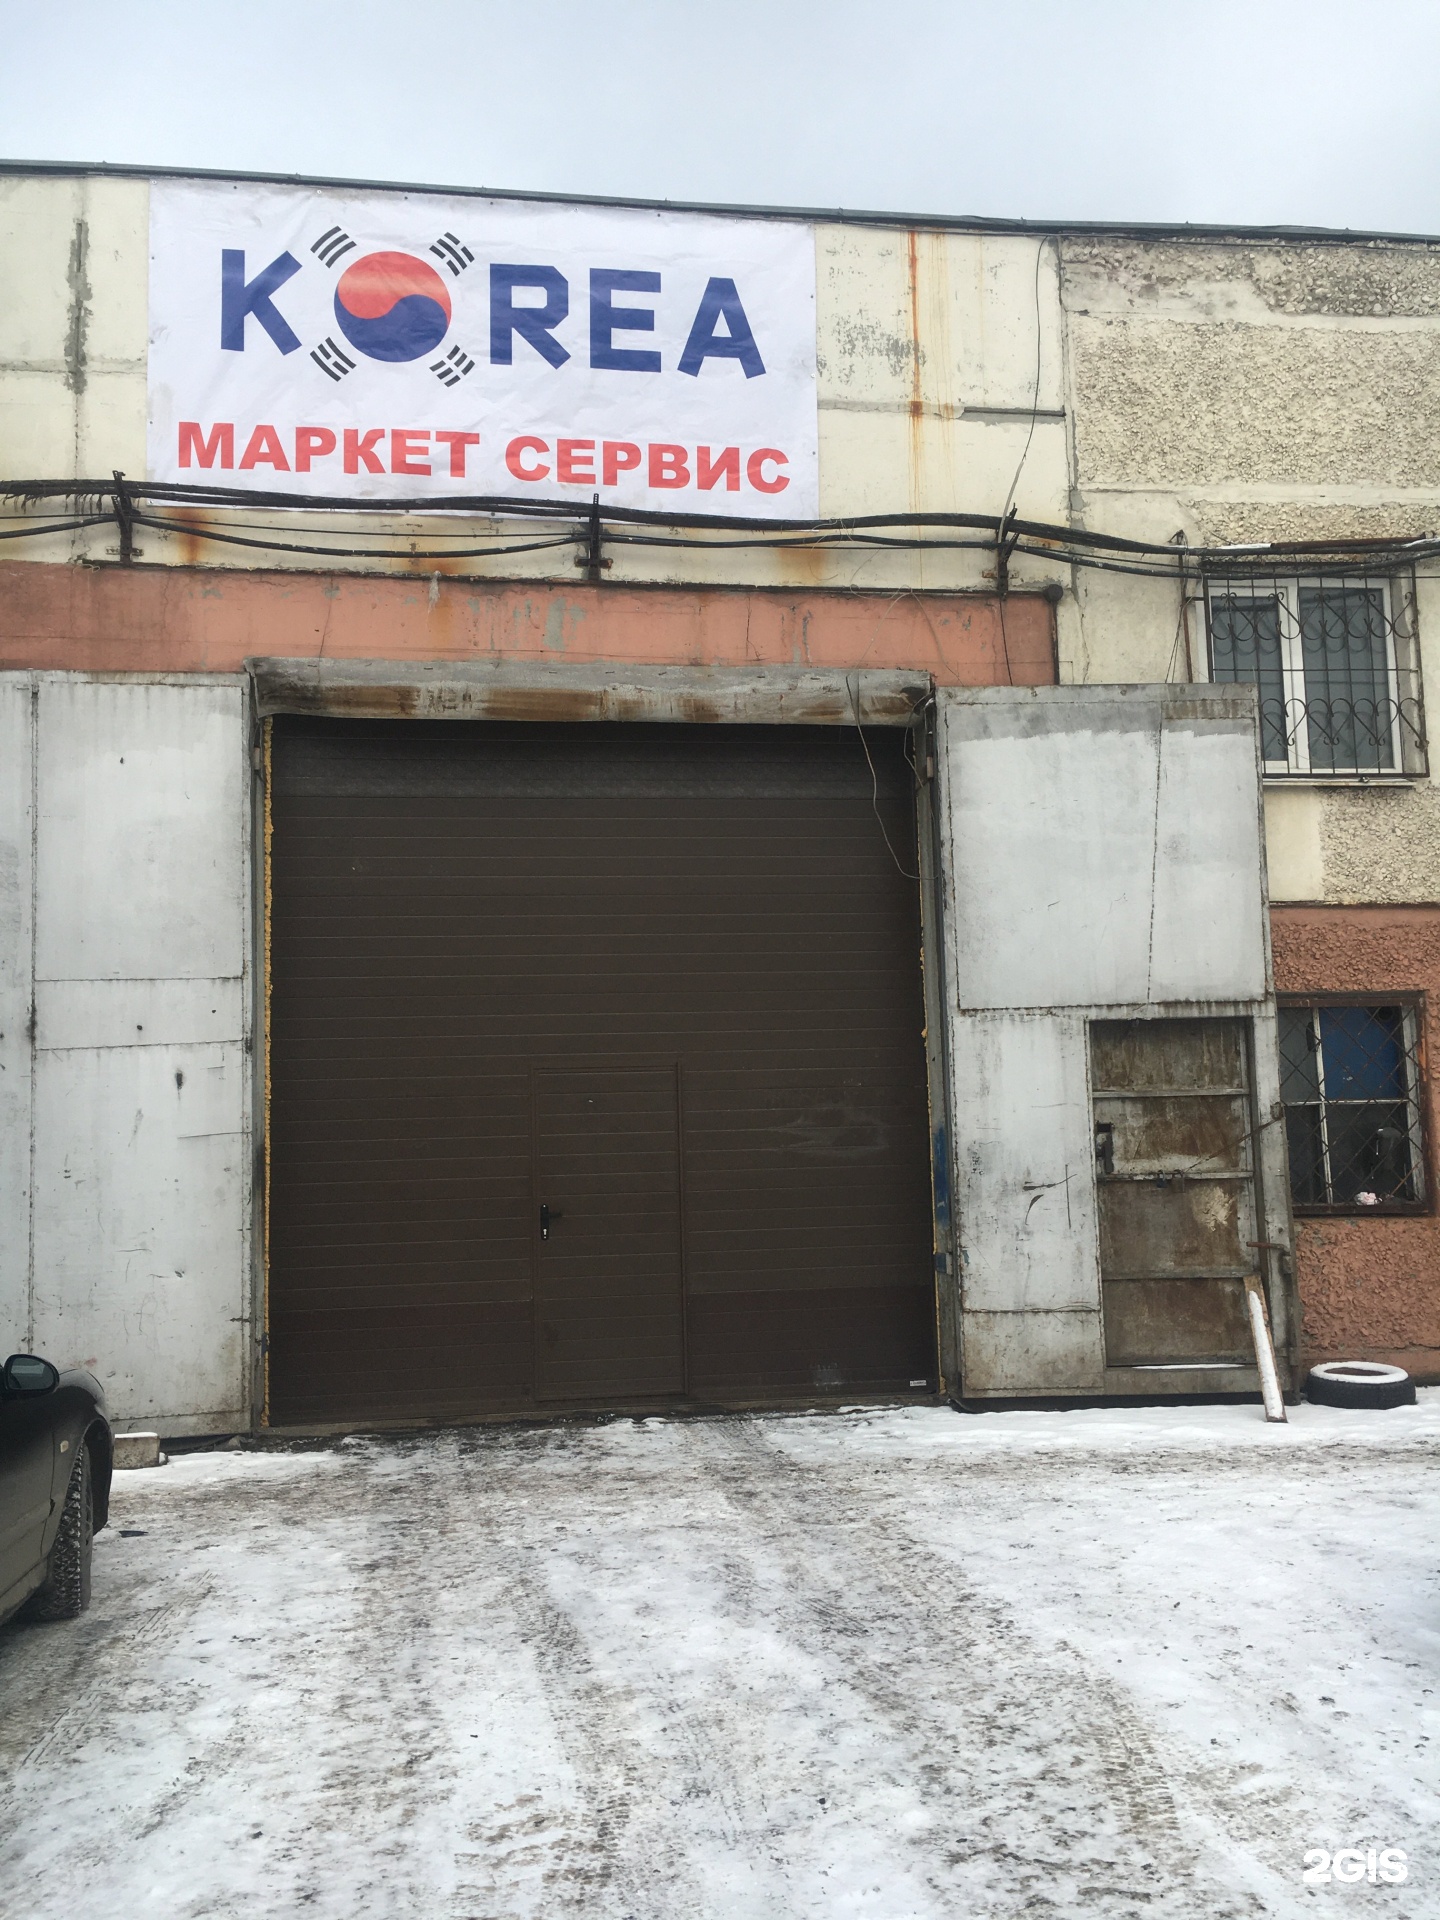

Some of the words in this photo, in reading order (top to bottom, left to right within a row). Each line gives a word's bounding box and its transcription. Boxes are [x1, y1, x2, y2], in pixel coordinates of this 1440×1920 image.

[221, 249, 766, 379] KOREA
[178, 421, 480, 478] МАРКЕТ
[505, 436, 790, 494] СЕРВИС
